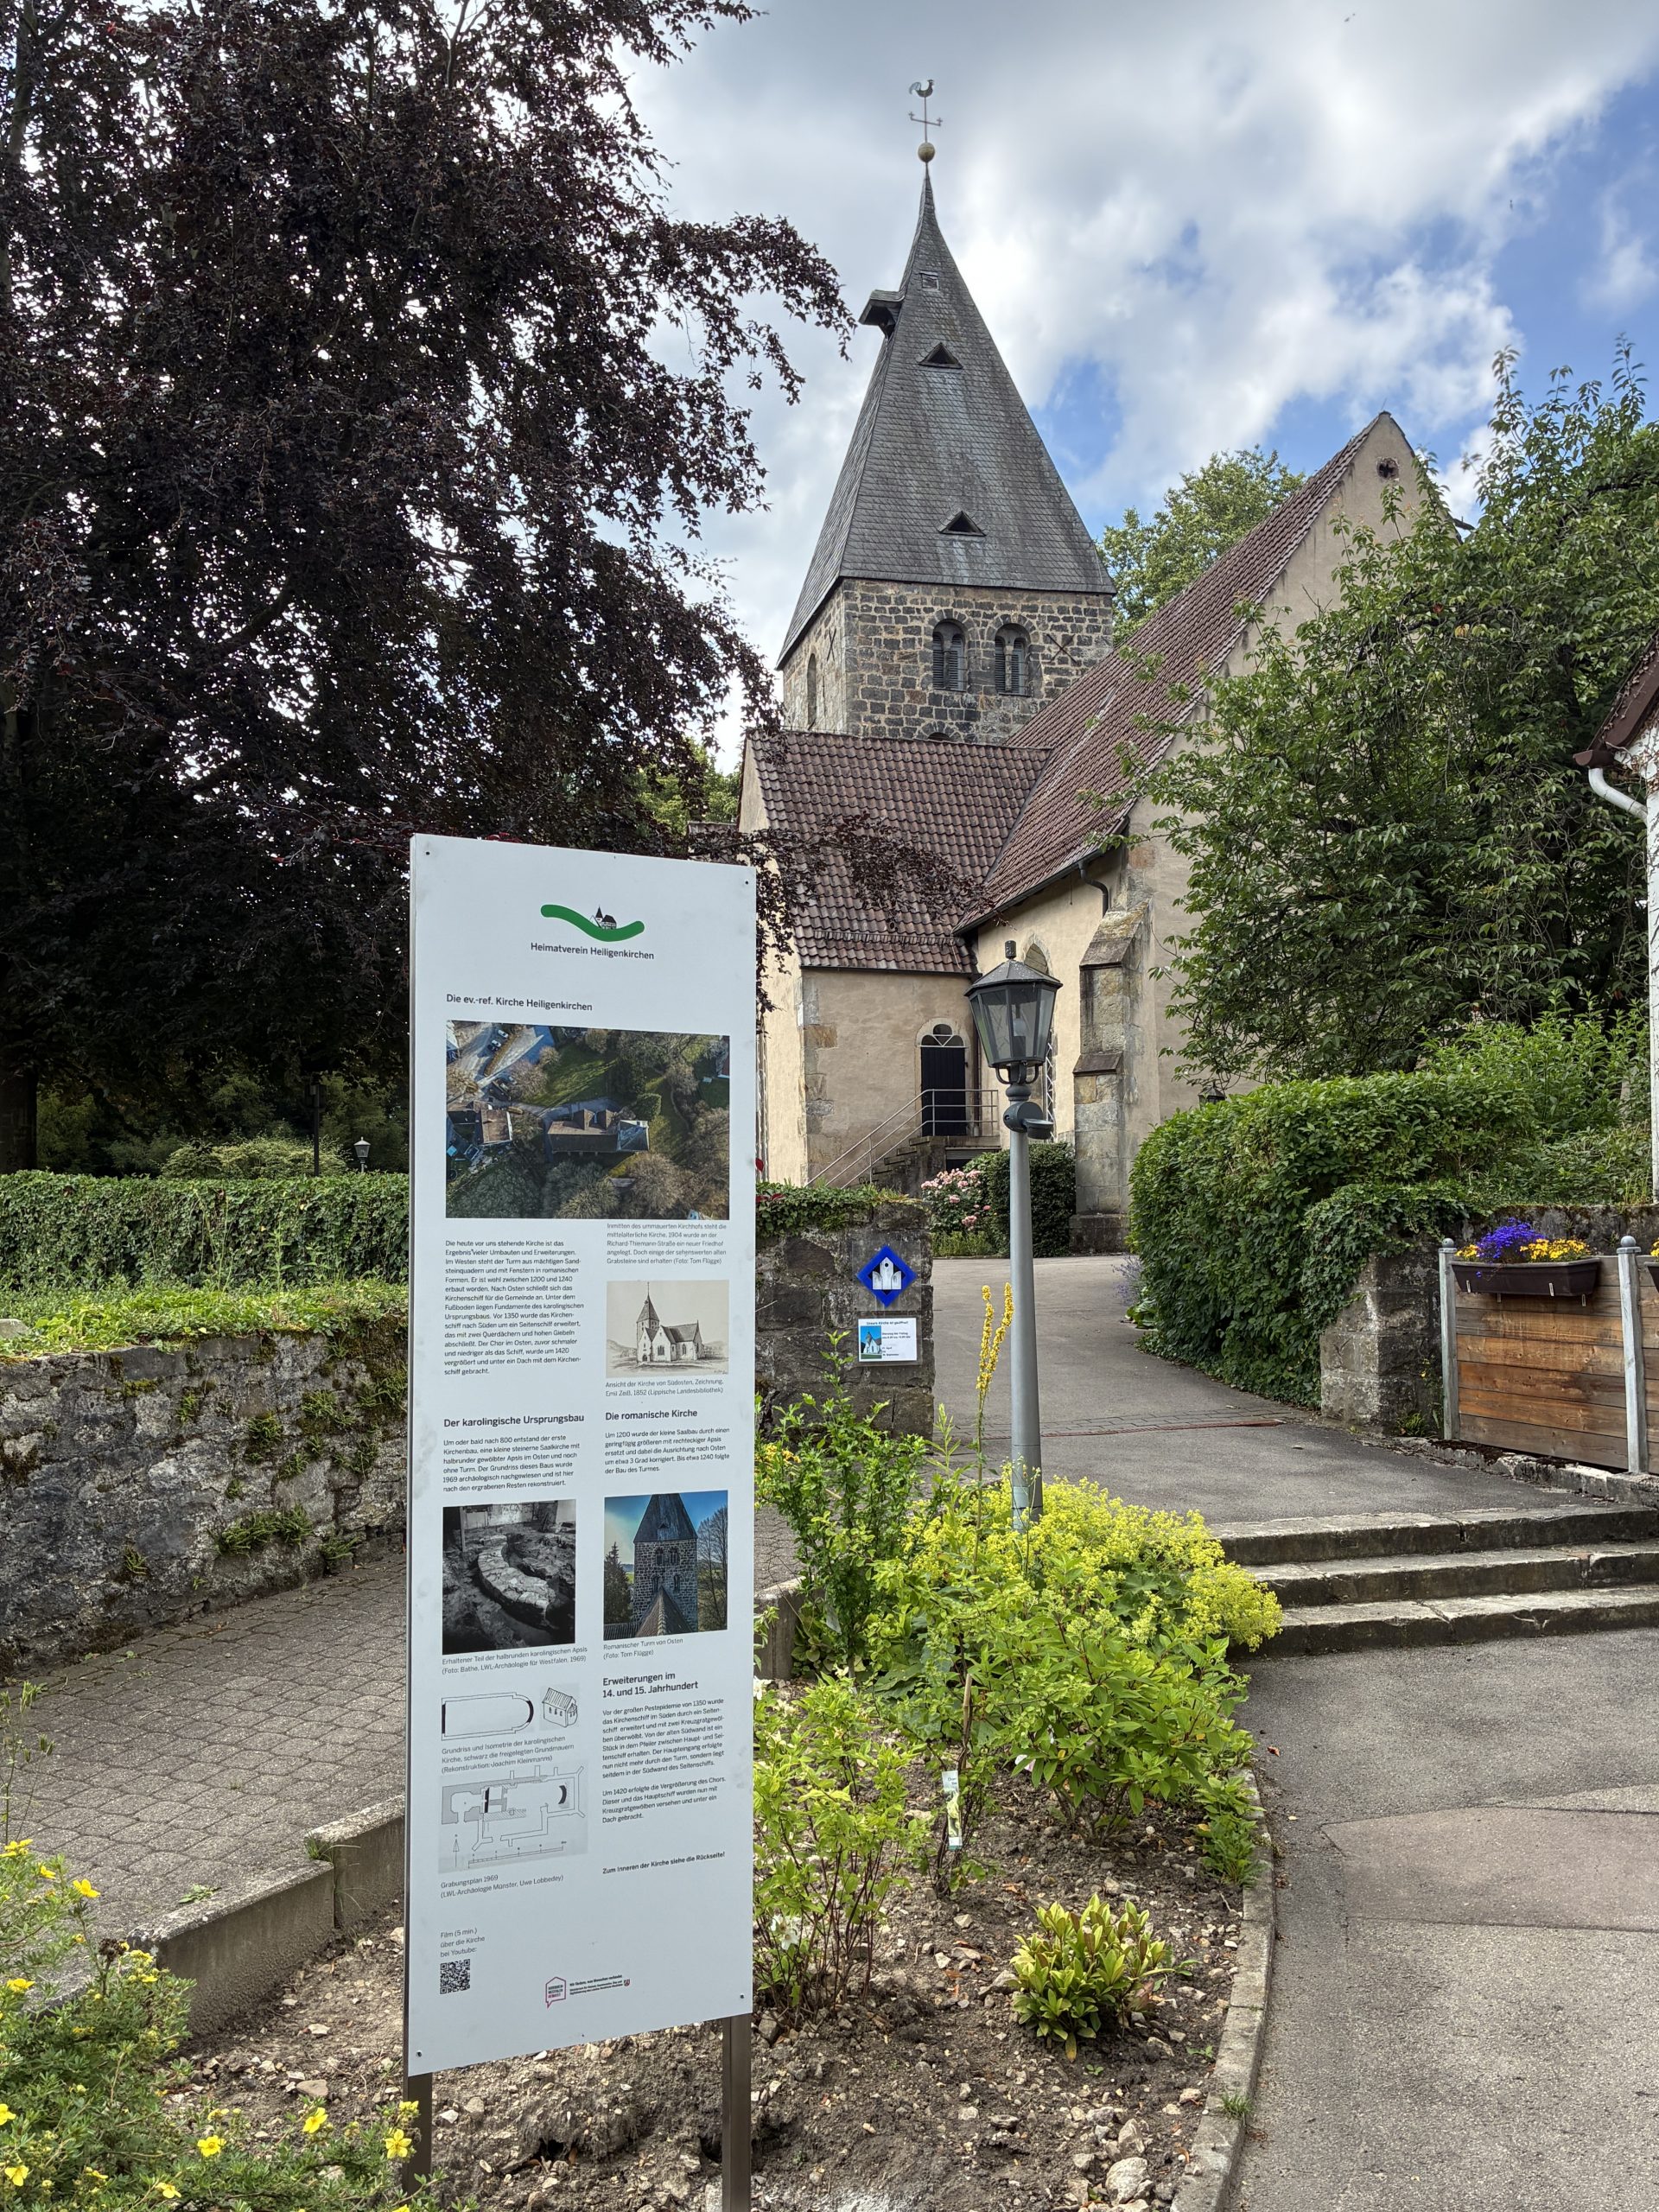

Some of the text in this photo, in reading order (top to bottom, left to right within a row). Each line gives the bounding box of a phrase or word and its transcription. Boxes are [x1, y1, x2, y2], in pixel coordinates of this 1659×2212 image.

[531, 943, 654, 959] Heimatverein Heiligenkirchen
[446, 994, 461, 1003] Die
[496, 997, 524, 1006] Kirche
[527, 999, 592, 1011] Heiligenkirchen
[621, 1411, 669, 1419] romanische
[444, 1415, 584, 1427] Der karolingische Ursprungsbau
[603, 1675, 663, 1686] Erweiterungen
[603, 1681, 698, 1698] 14. und 15. Jahrhundert
[618, 1813, 644, 1822] gebracht.
[696, 1852, 725, 1860] Rückseite!
[451, 1947, 477, 1955] Youtube:
